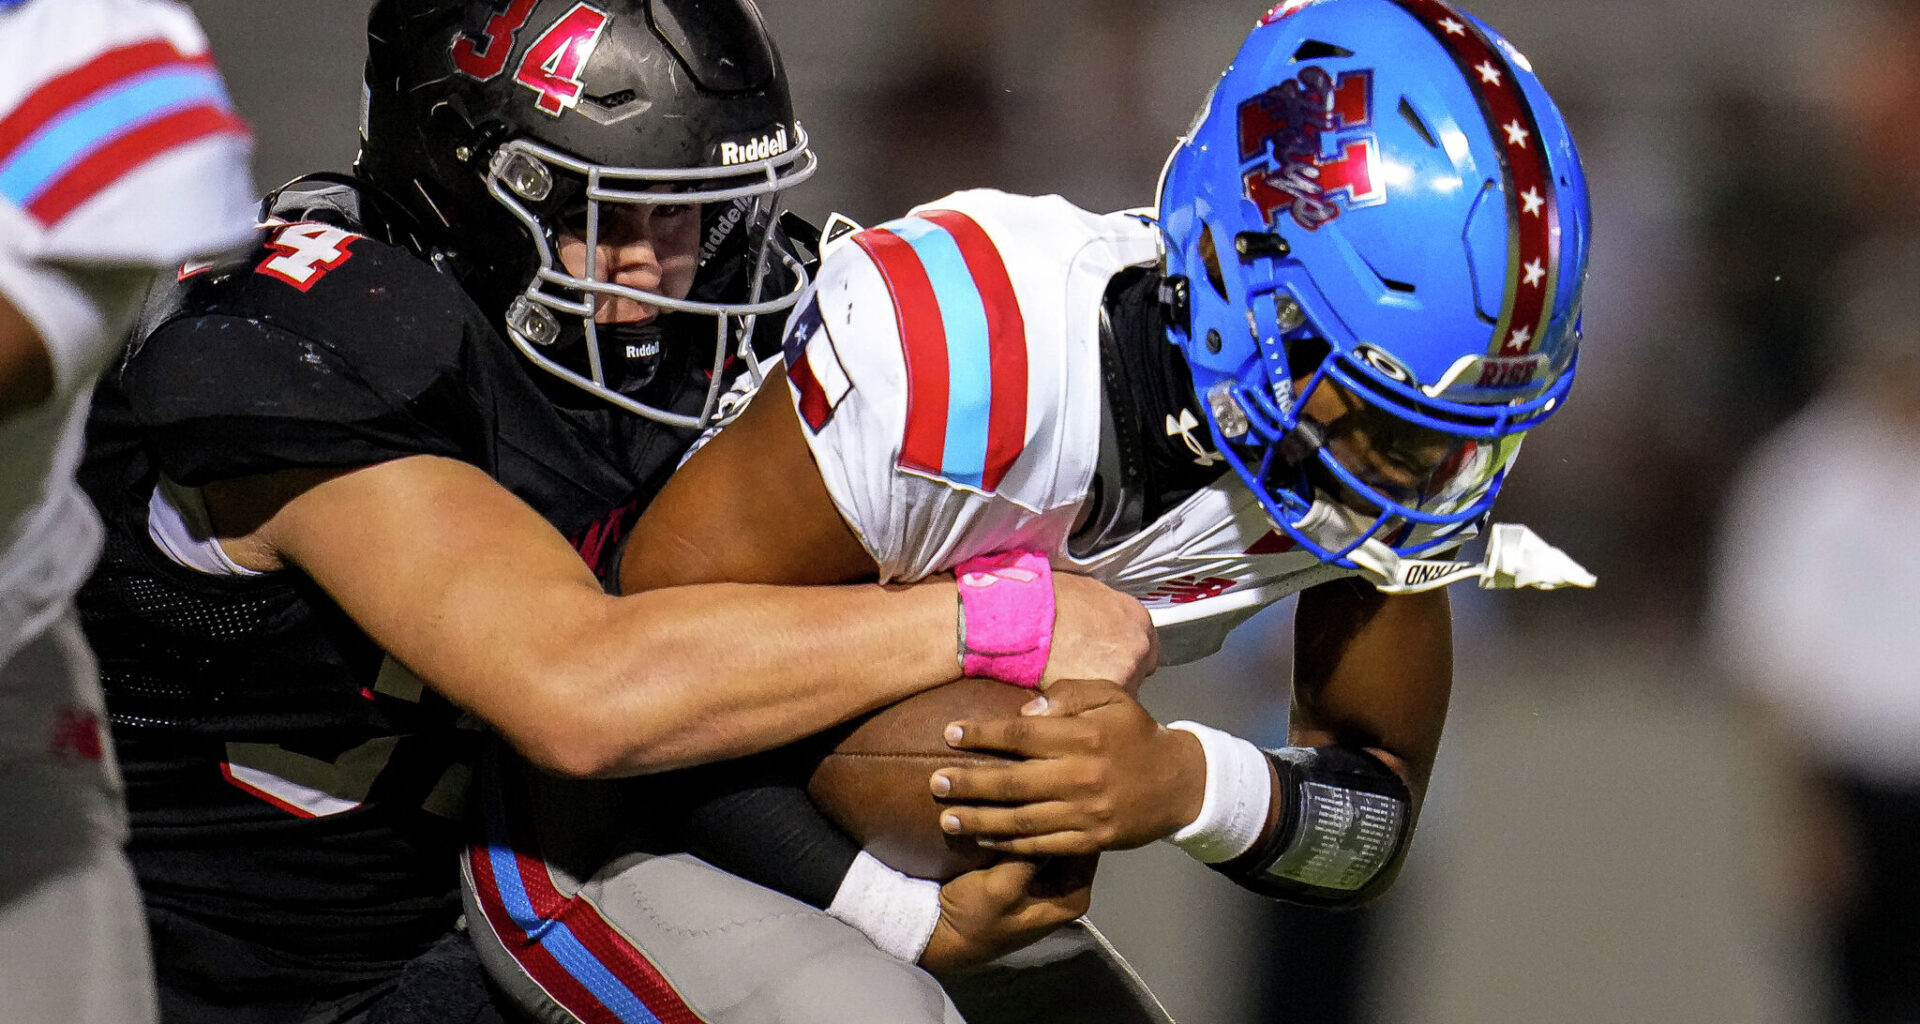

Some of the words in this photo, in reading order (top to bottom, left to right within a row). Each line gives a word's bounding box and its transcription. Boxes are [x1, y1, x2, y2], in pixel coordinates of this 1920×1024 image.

[450, 0, 608, 118] 34
[721, 128, 789, 166] Riddell
[625, 340, 660, 359] Riddell
[1404, 563, 1464, 586] TRND
